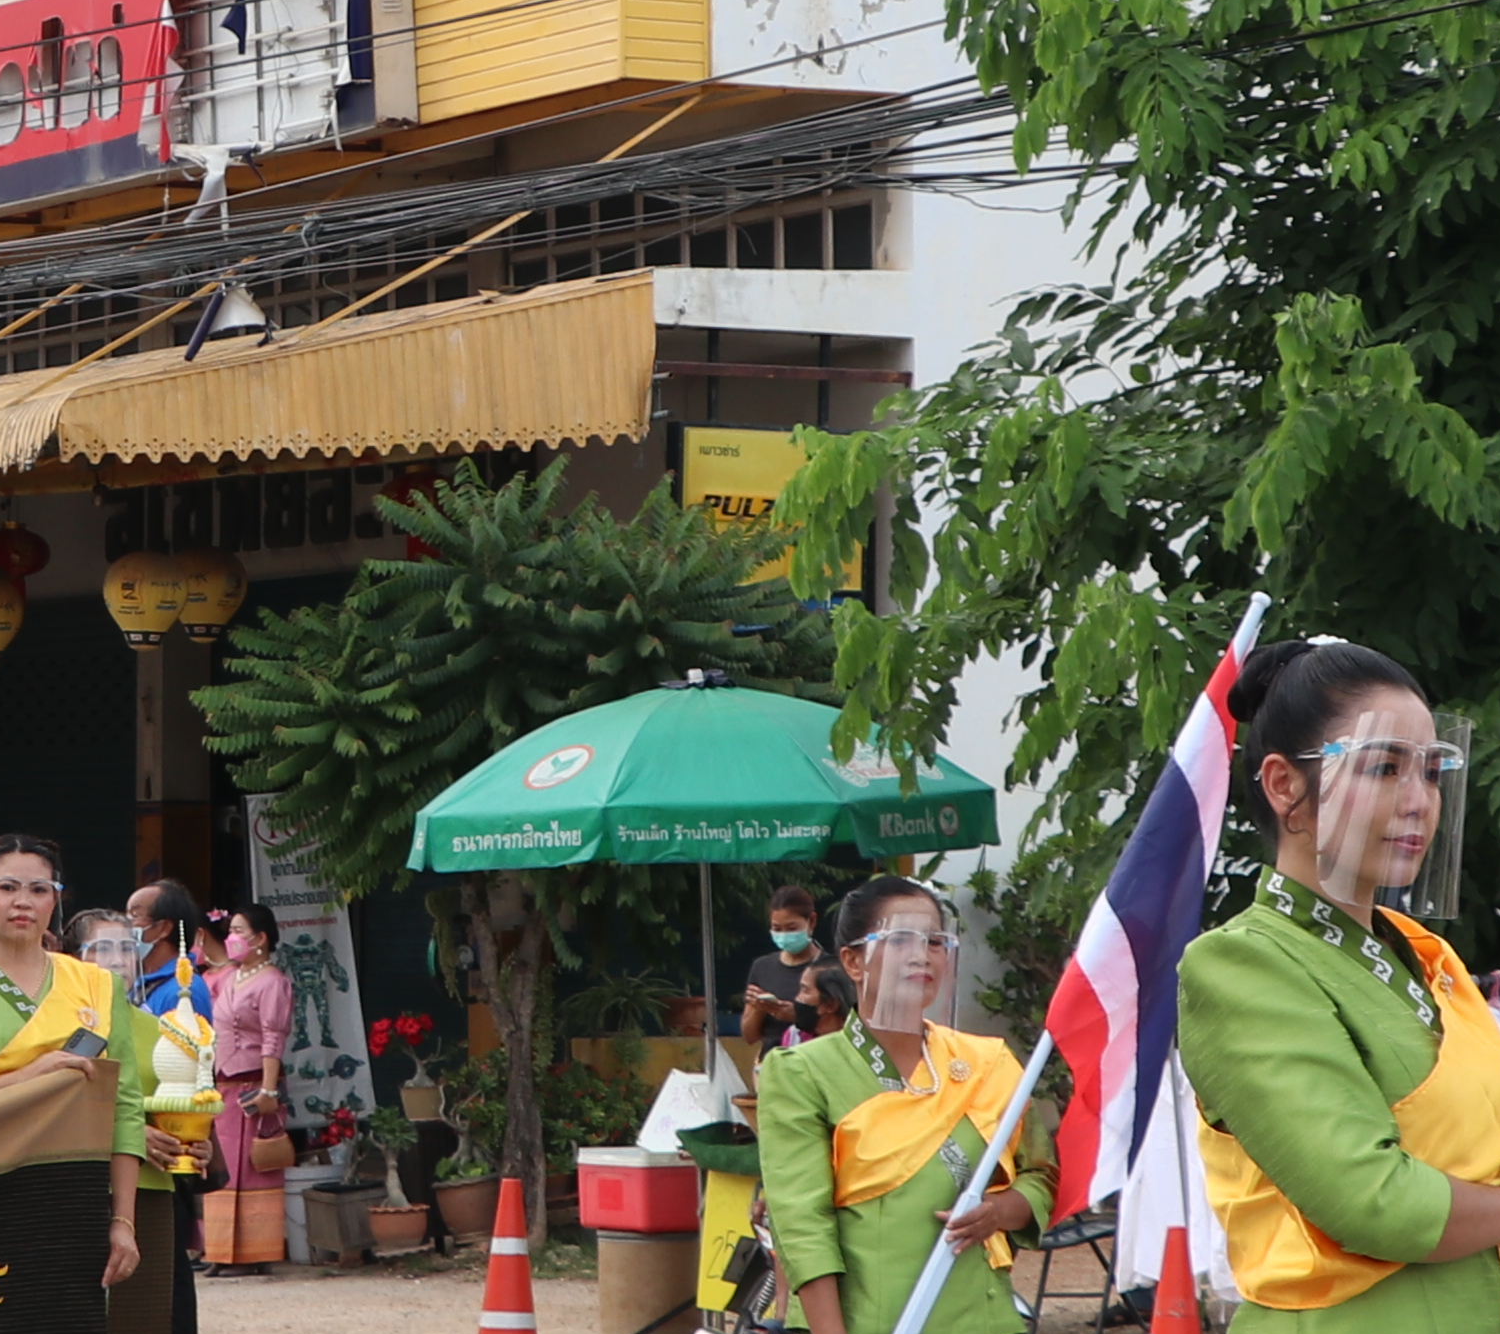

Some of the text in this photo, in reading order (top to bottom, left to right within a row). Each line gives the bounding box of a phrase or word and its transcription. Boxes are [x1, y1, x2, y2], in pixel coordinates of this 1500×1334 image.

[704, 494, 774, 518] PULZ
[618, 824, 669, 842] ร้านเล็ก
[674, 821, 733, 843] ร้านใหญ่
[878, 806, 936, 838] KBank
[452, 820, 581, 853] ธนาคารกสิกรไทย
